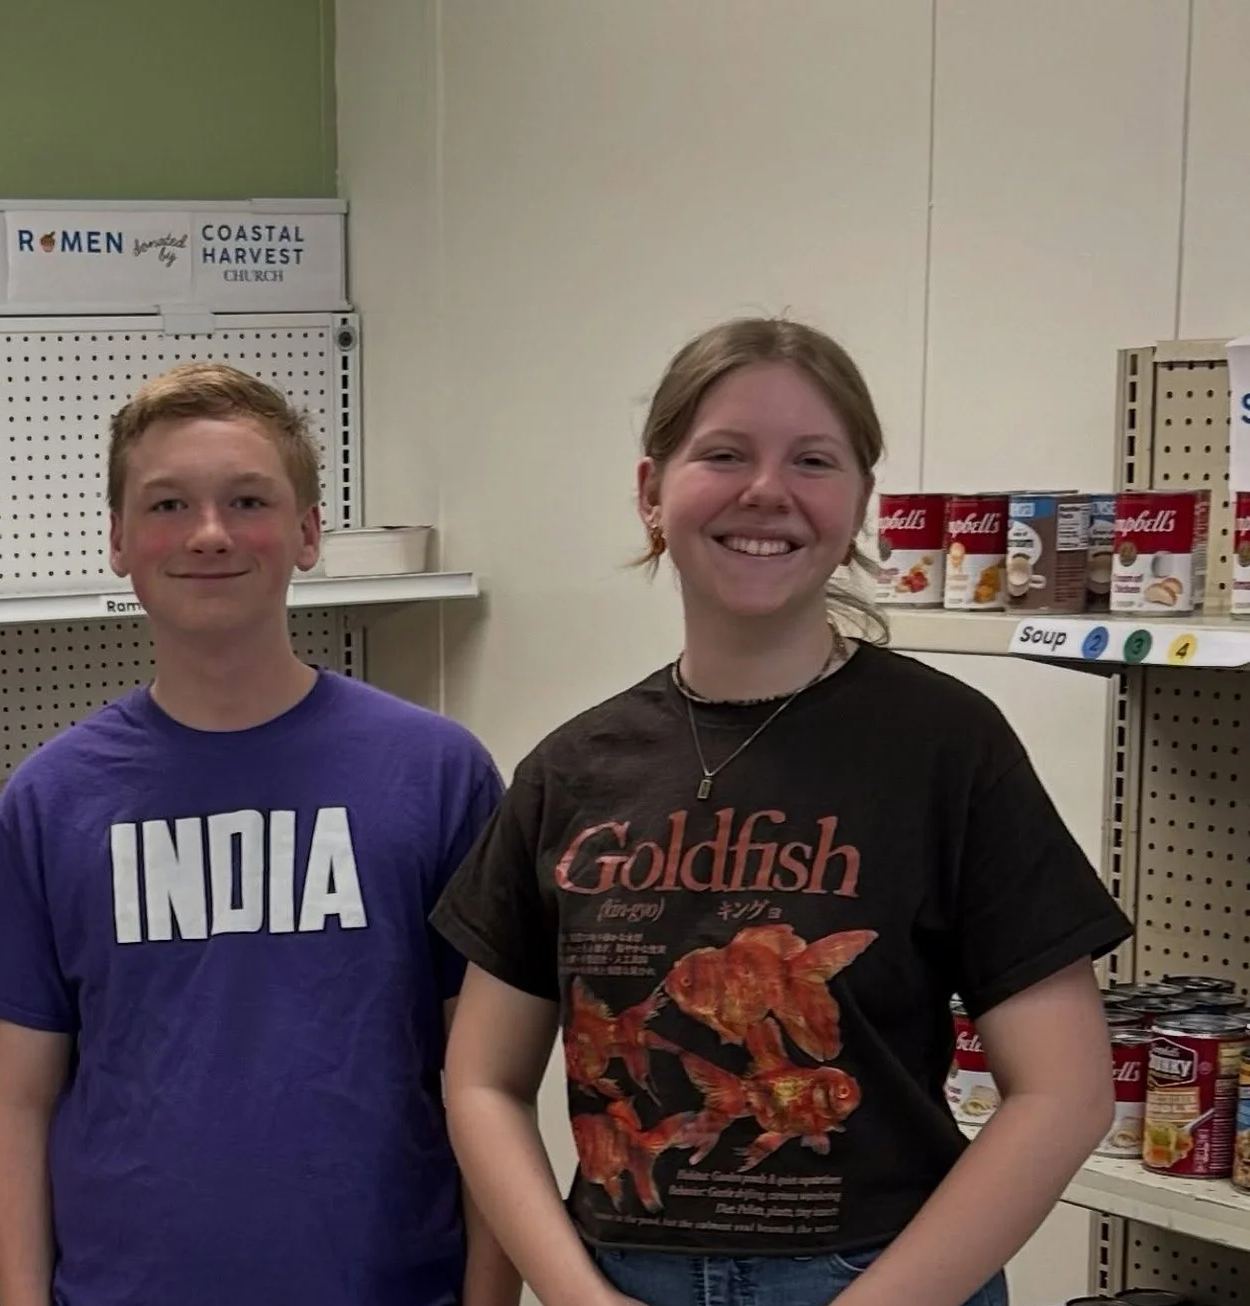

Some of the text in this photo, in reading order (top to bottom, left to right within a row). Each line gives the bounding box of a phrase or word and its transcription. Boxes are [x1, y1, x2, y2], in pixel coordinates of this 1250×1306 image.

[18, 230, 124, 254] RMEN
[133, 233, 188, 258] donated
[201, 224, 305, 243] COASTAL
[158, 246, 177, 267] by
[202, 248, 305, 266] HARVEST
[223, 269, 284, 283] CHURCH
[1020, 626, 1191, 660] Soup 2 3 4
[555, 807, 860, 898] Goldfish
[110, 806, 368, 944] INDIA
